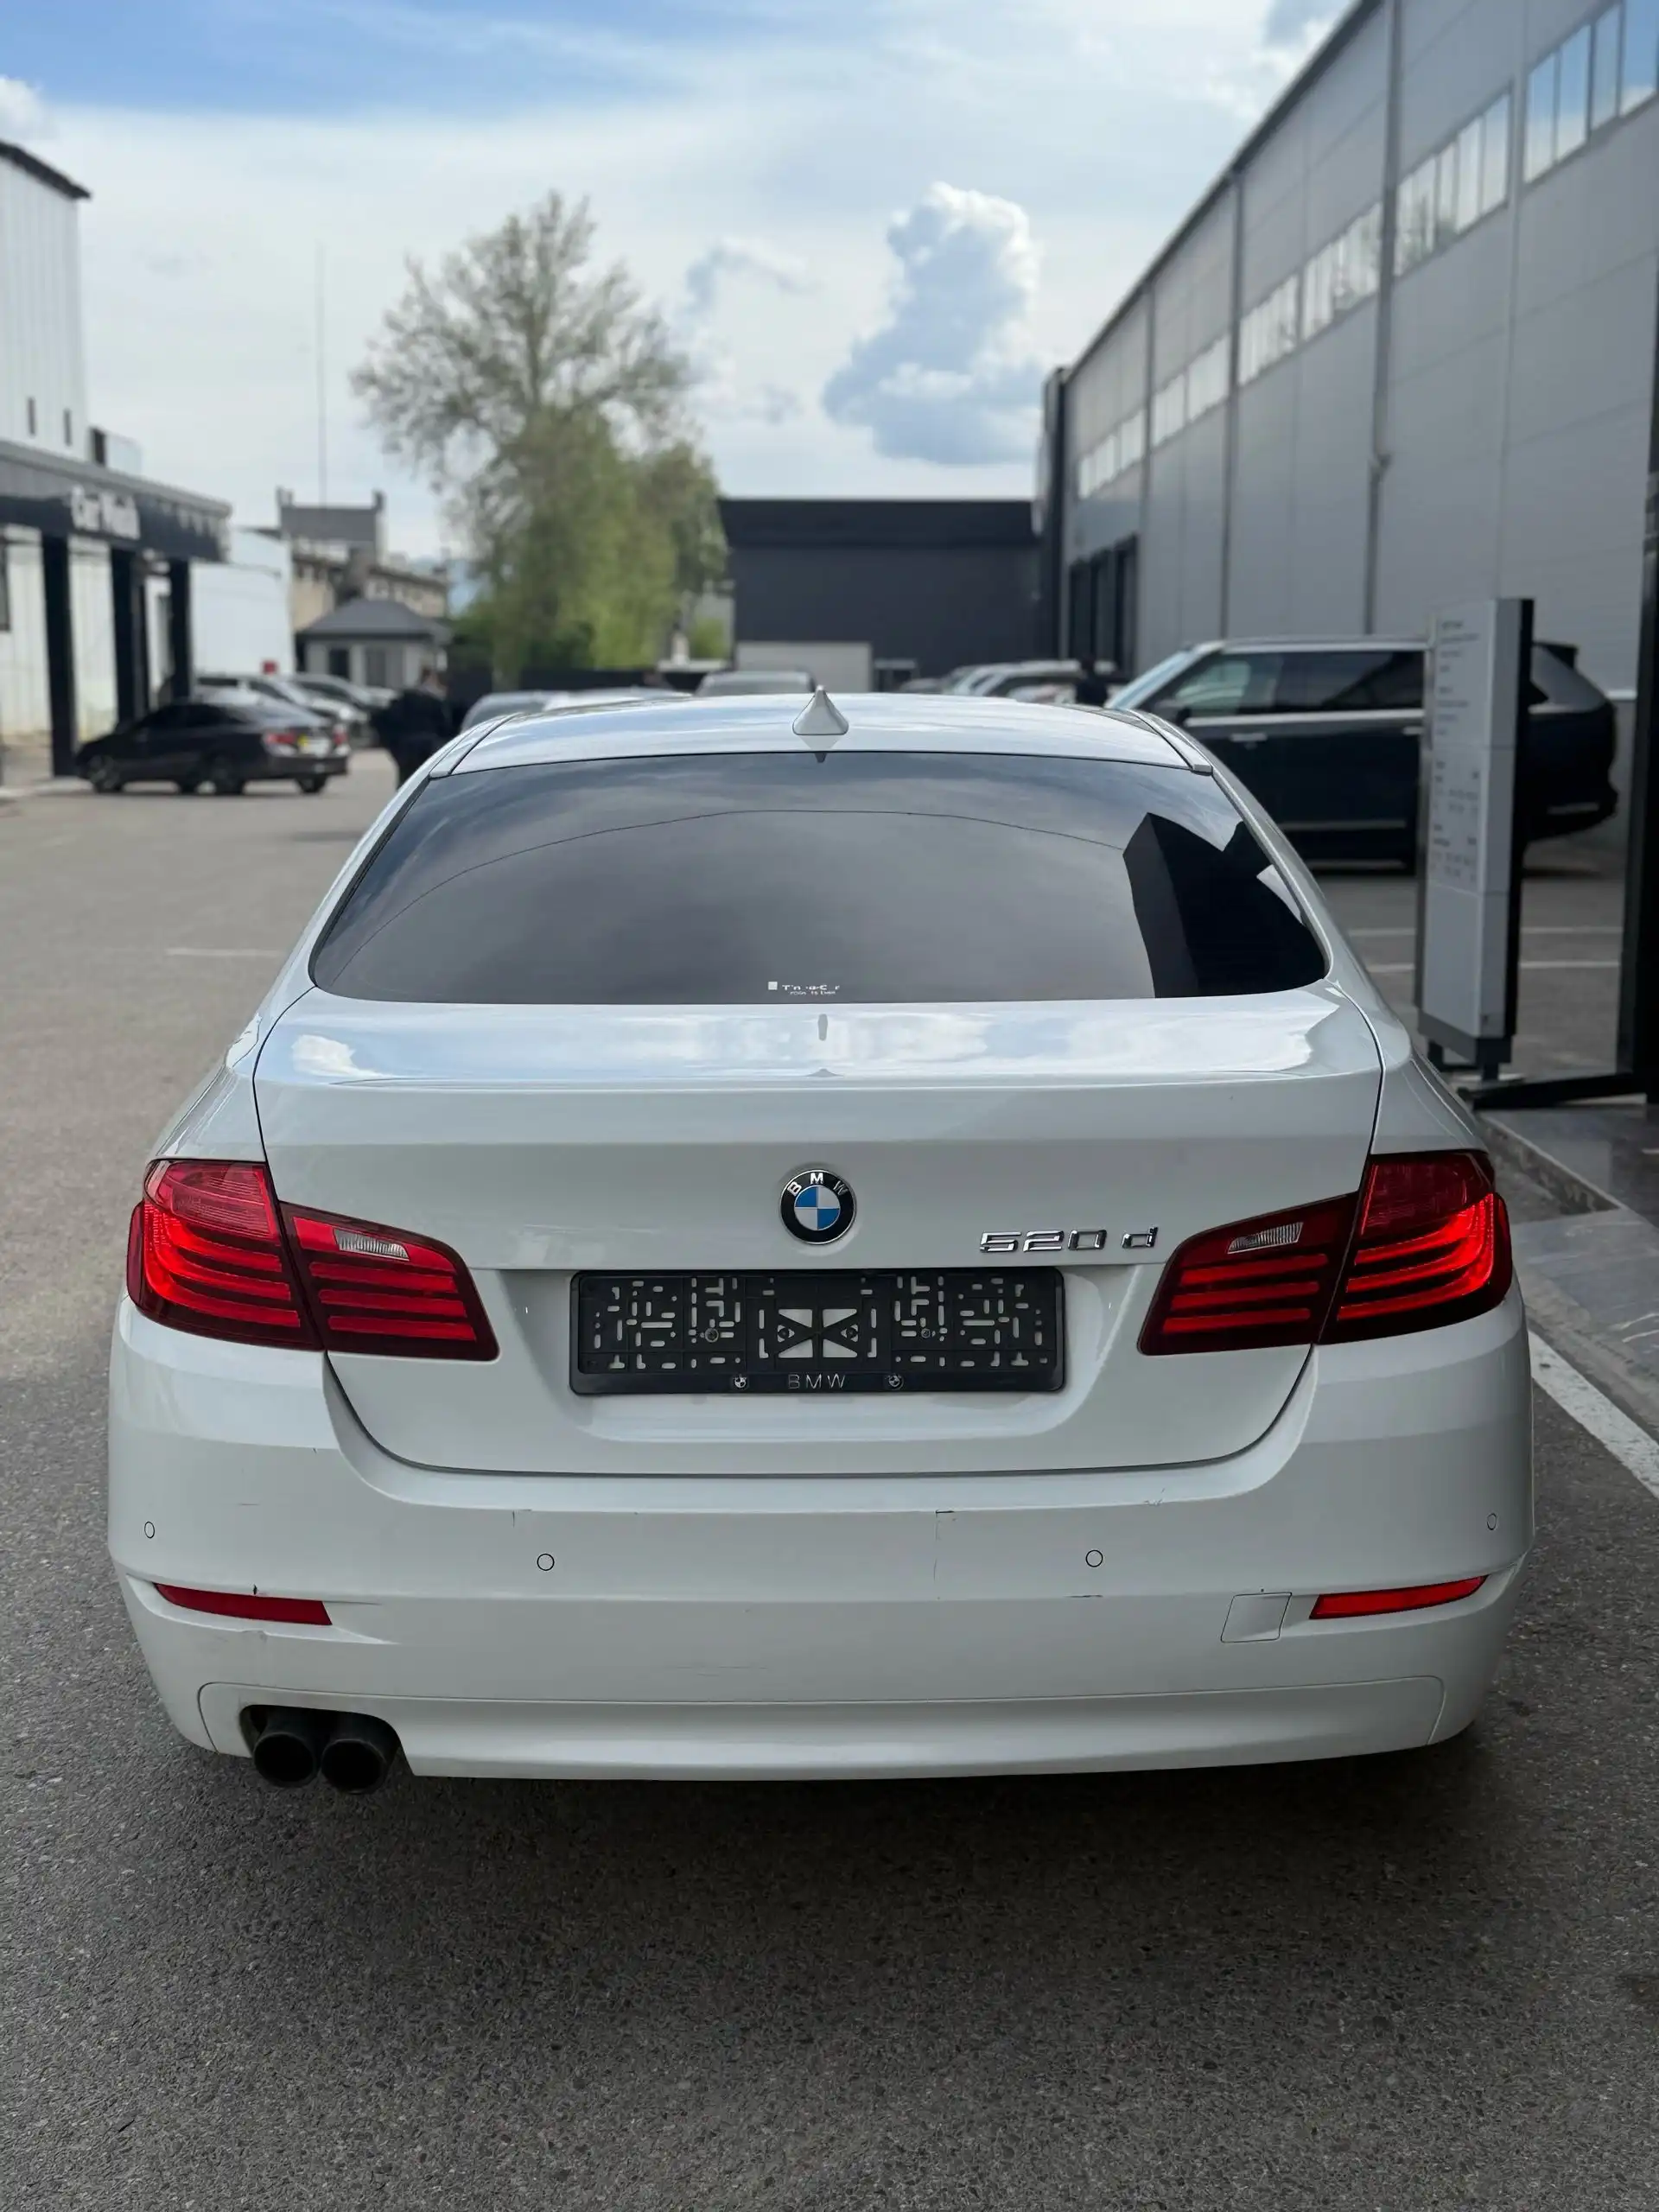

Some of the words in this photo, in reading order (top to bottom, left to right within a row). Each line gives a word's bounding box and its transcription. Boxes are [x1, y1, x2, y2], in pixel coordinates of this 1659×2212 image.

[787, 1172, 849, 1197] BMW
[979, 1229, 1108, 1253] 520
[1122, 1226, 1159, 1249] d
[787, 1373, 846, 1389] BMW
